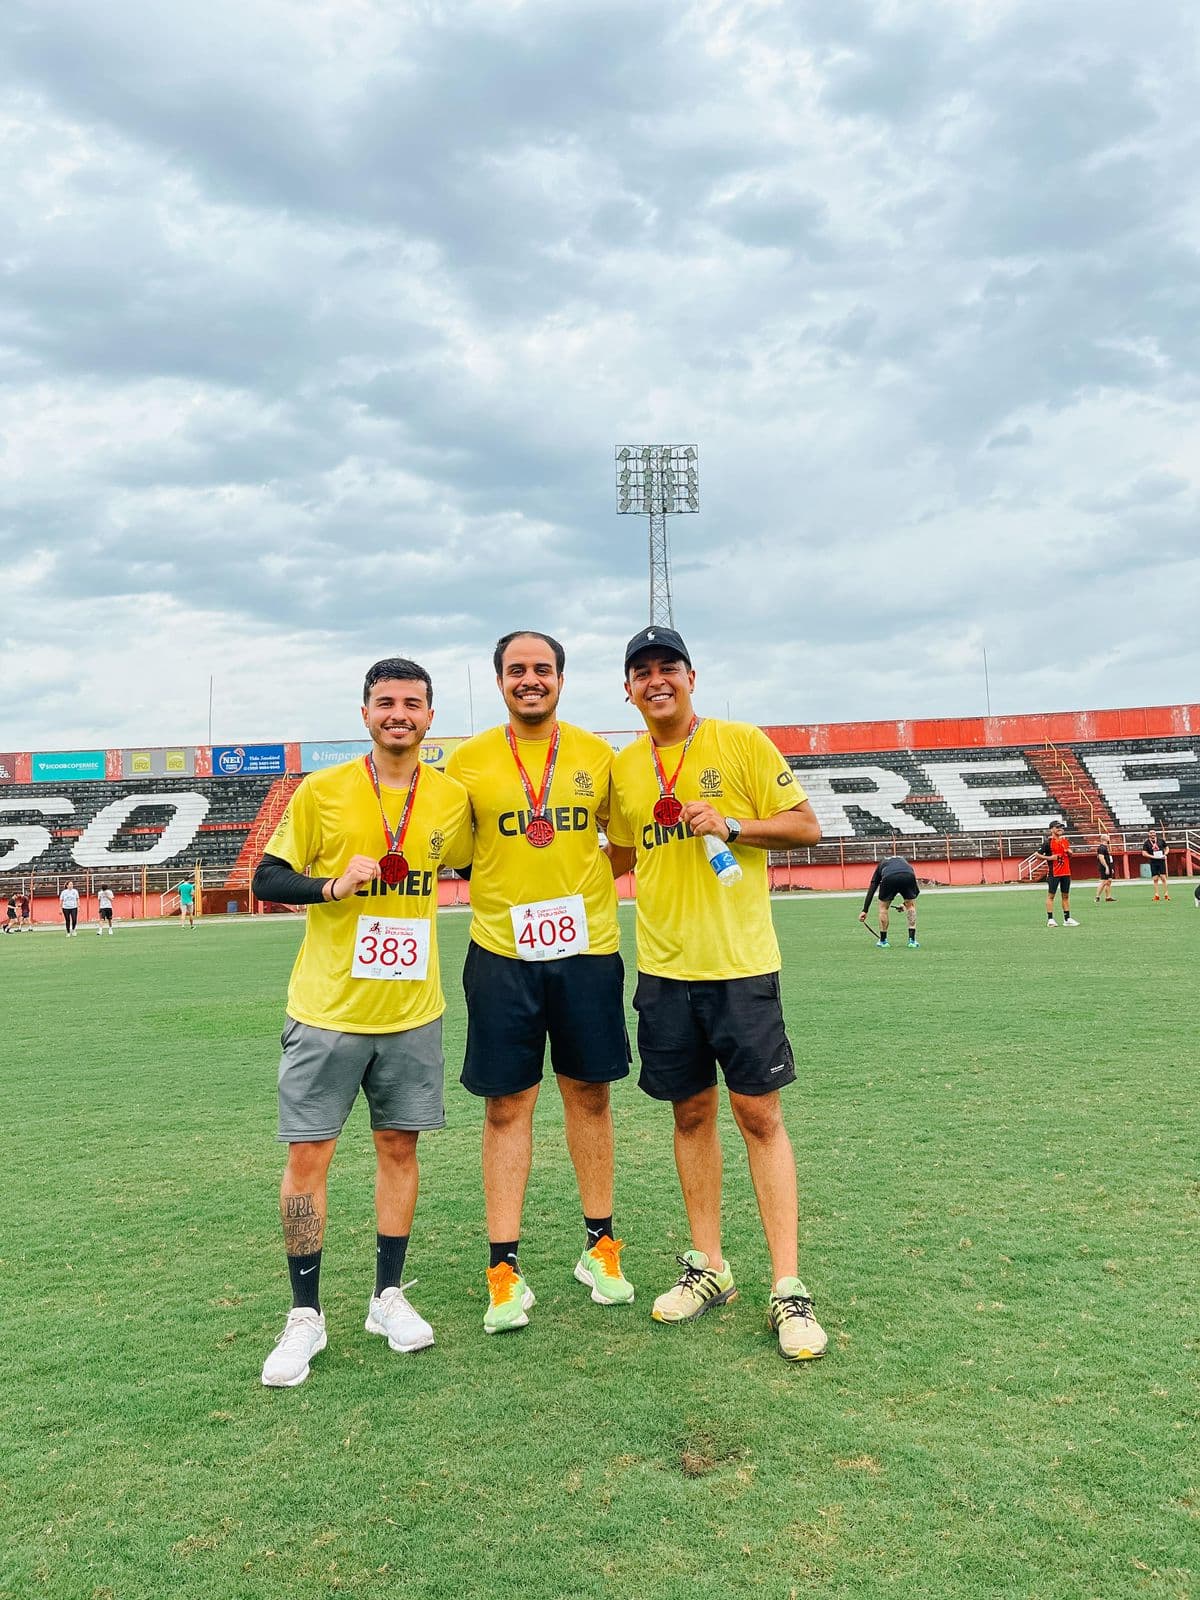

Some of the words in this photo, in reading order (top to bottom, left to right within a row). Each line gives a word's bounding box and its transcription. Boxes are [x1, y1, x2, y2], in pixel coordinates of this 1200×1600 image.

[353, 870, 432, 897] IMED
[518, 915, 577, 949] 408
[358, 936, 418, 967] 383
